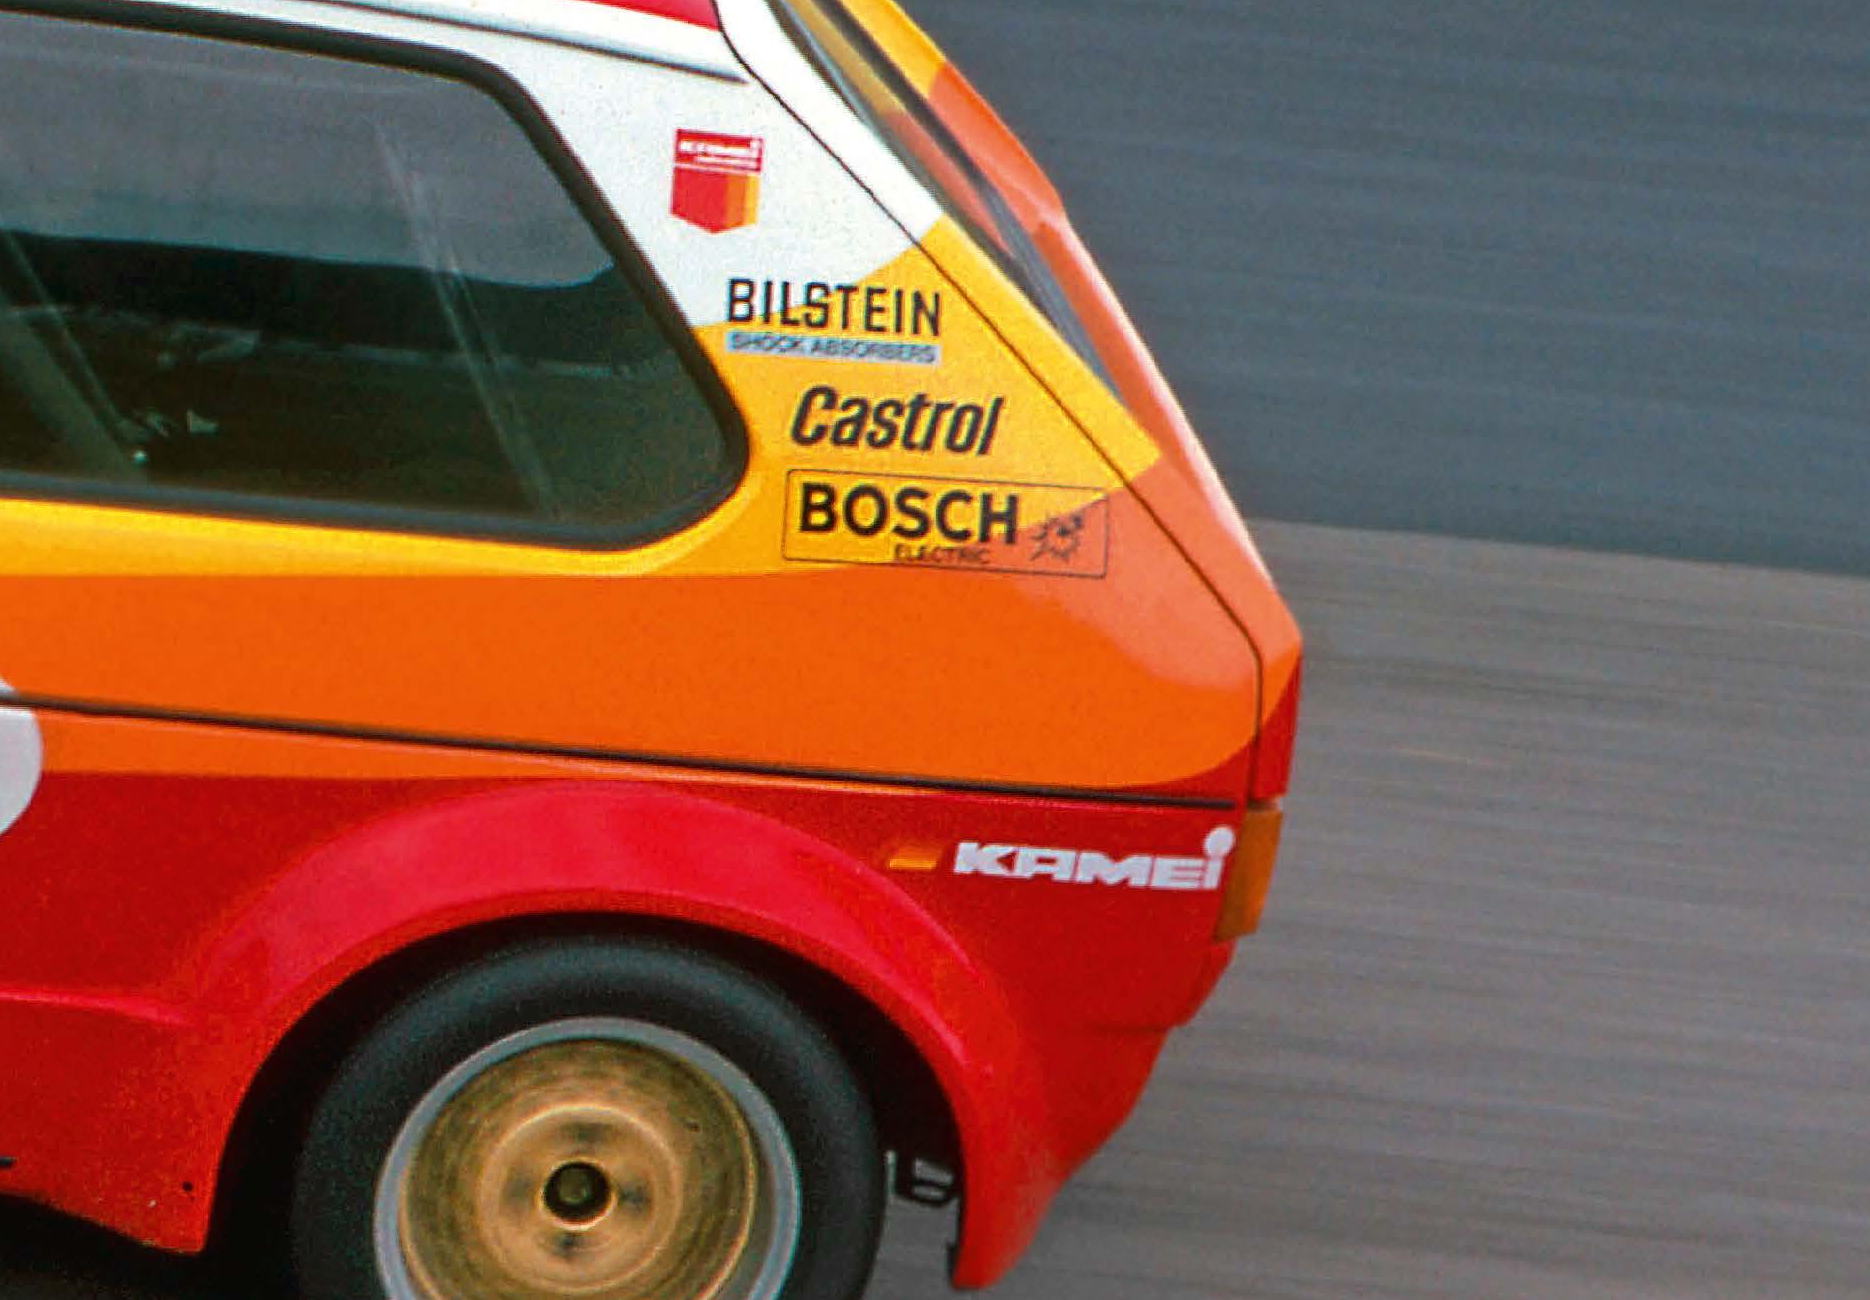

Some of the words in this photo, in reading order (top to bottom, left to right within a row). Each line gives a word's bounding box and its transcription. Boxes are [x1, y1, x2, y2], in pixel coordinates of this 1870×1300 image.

[727, 277, 941, 337] BILSTEIN
[790, 384, 1005, 457] Castrol
[799, 482, 1019, 545] BOSCH
[953, 825, 1236, 891] KAMEI
